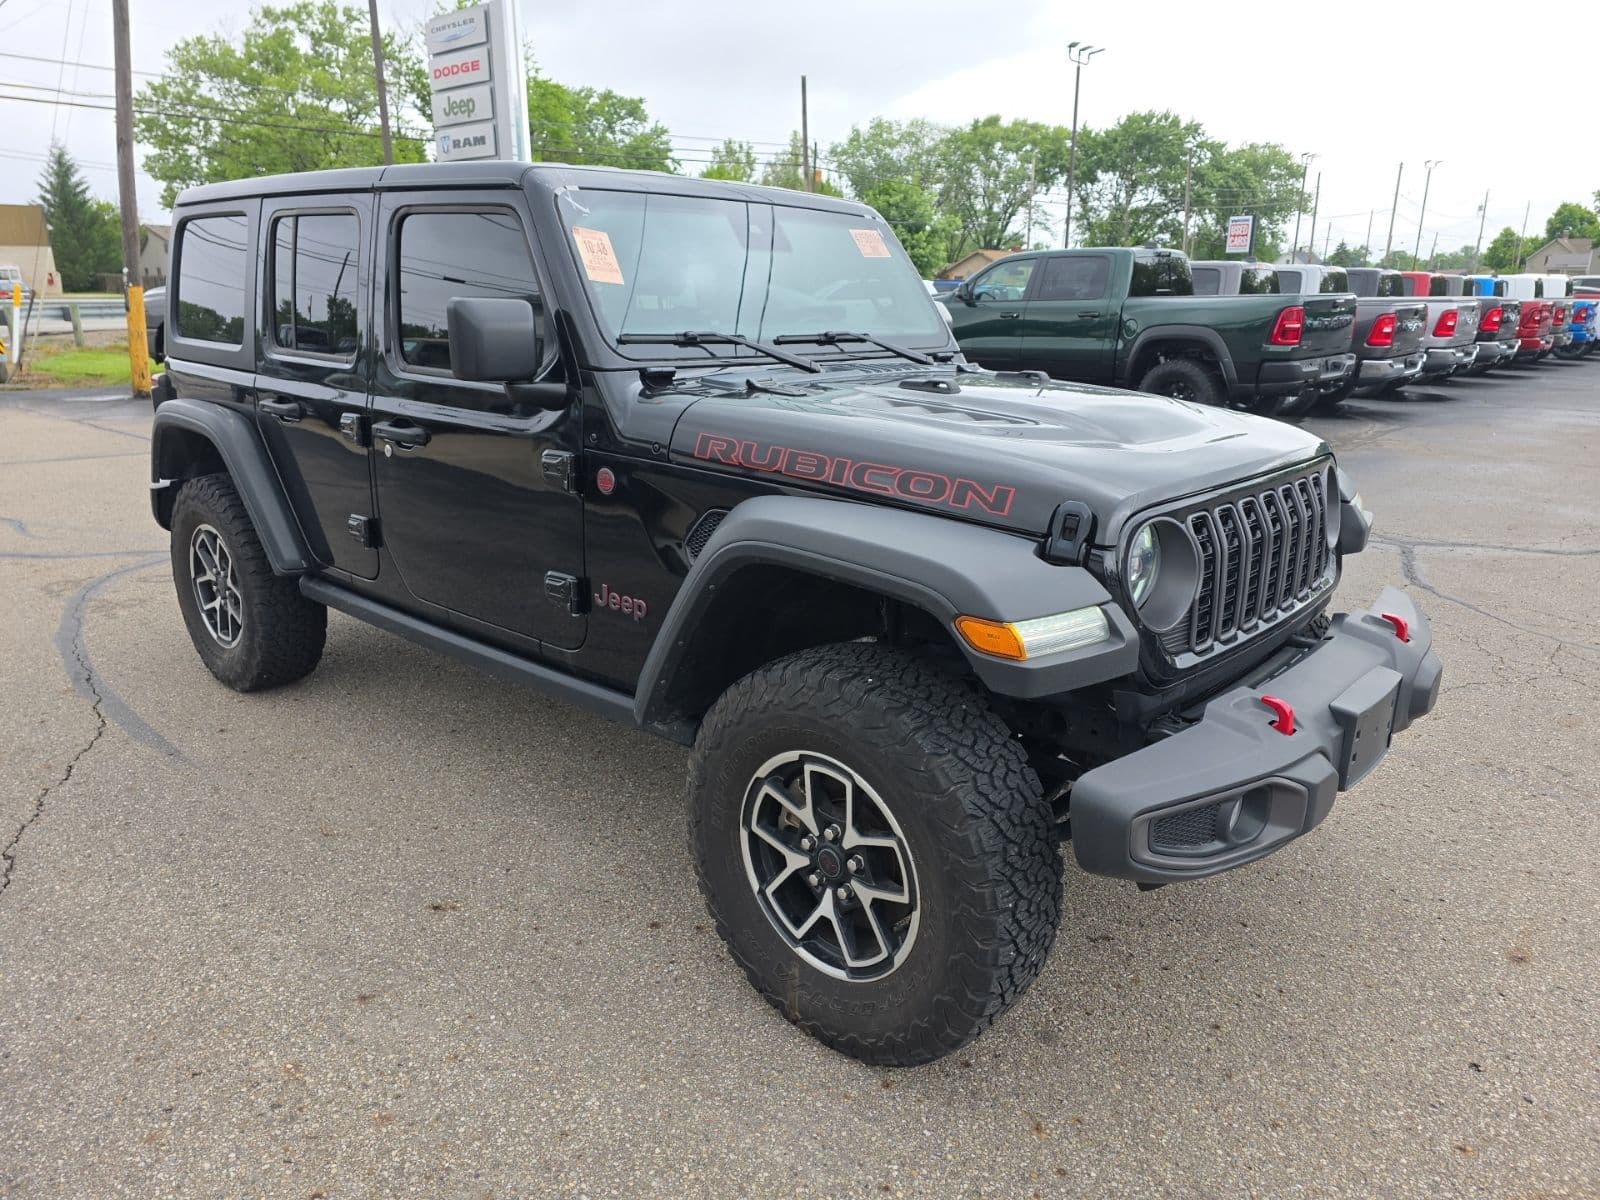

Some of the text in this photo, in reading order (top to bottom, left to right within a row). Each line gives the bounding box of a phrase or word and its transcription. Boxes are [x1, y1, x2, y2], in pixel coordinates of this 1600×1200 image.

[431, 17, 475, 34] CHRYSLER
[433, 60, 480, 79] DODGE
[443, 96, 476, 118] Jeep
[452, 135, 486, 149] RAM
[694, 432, 1015, 516] RUBICON
[594, 583, 647, 622] Jeep
